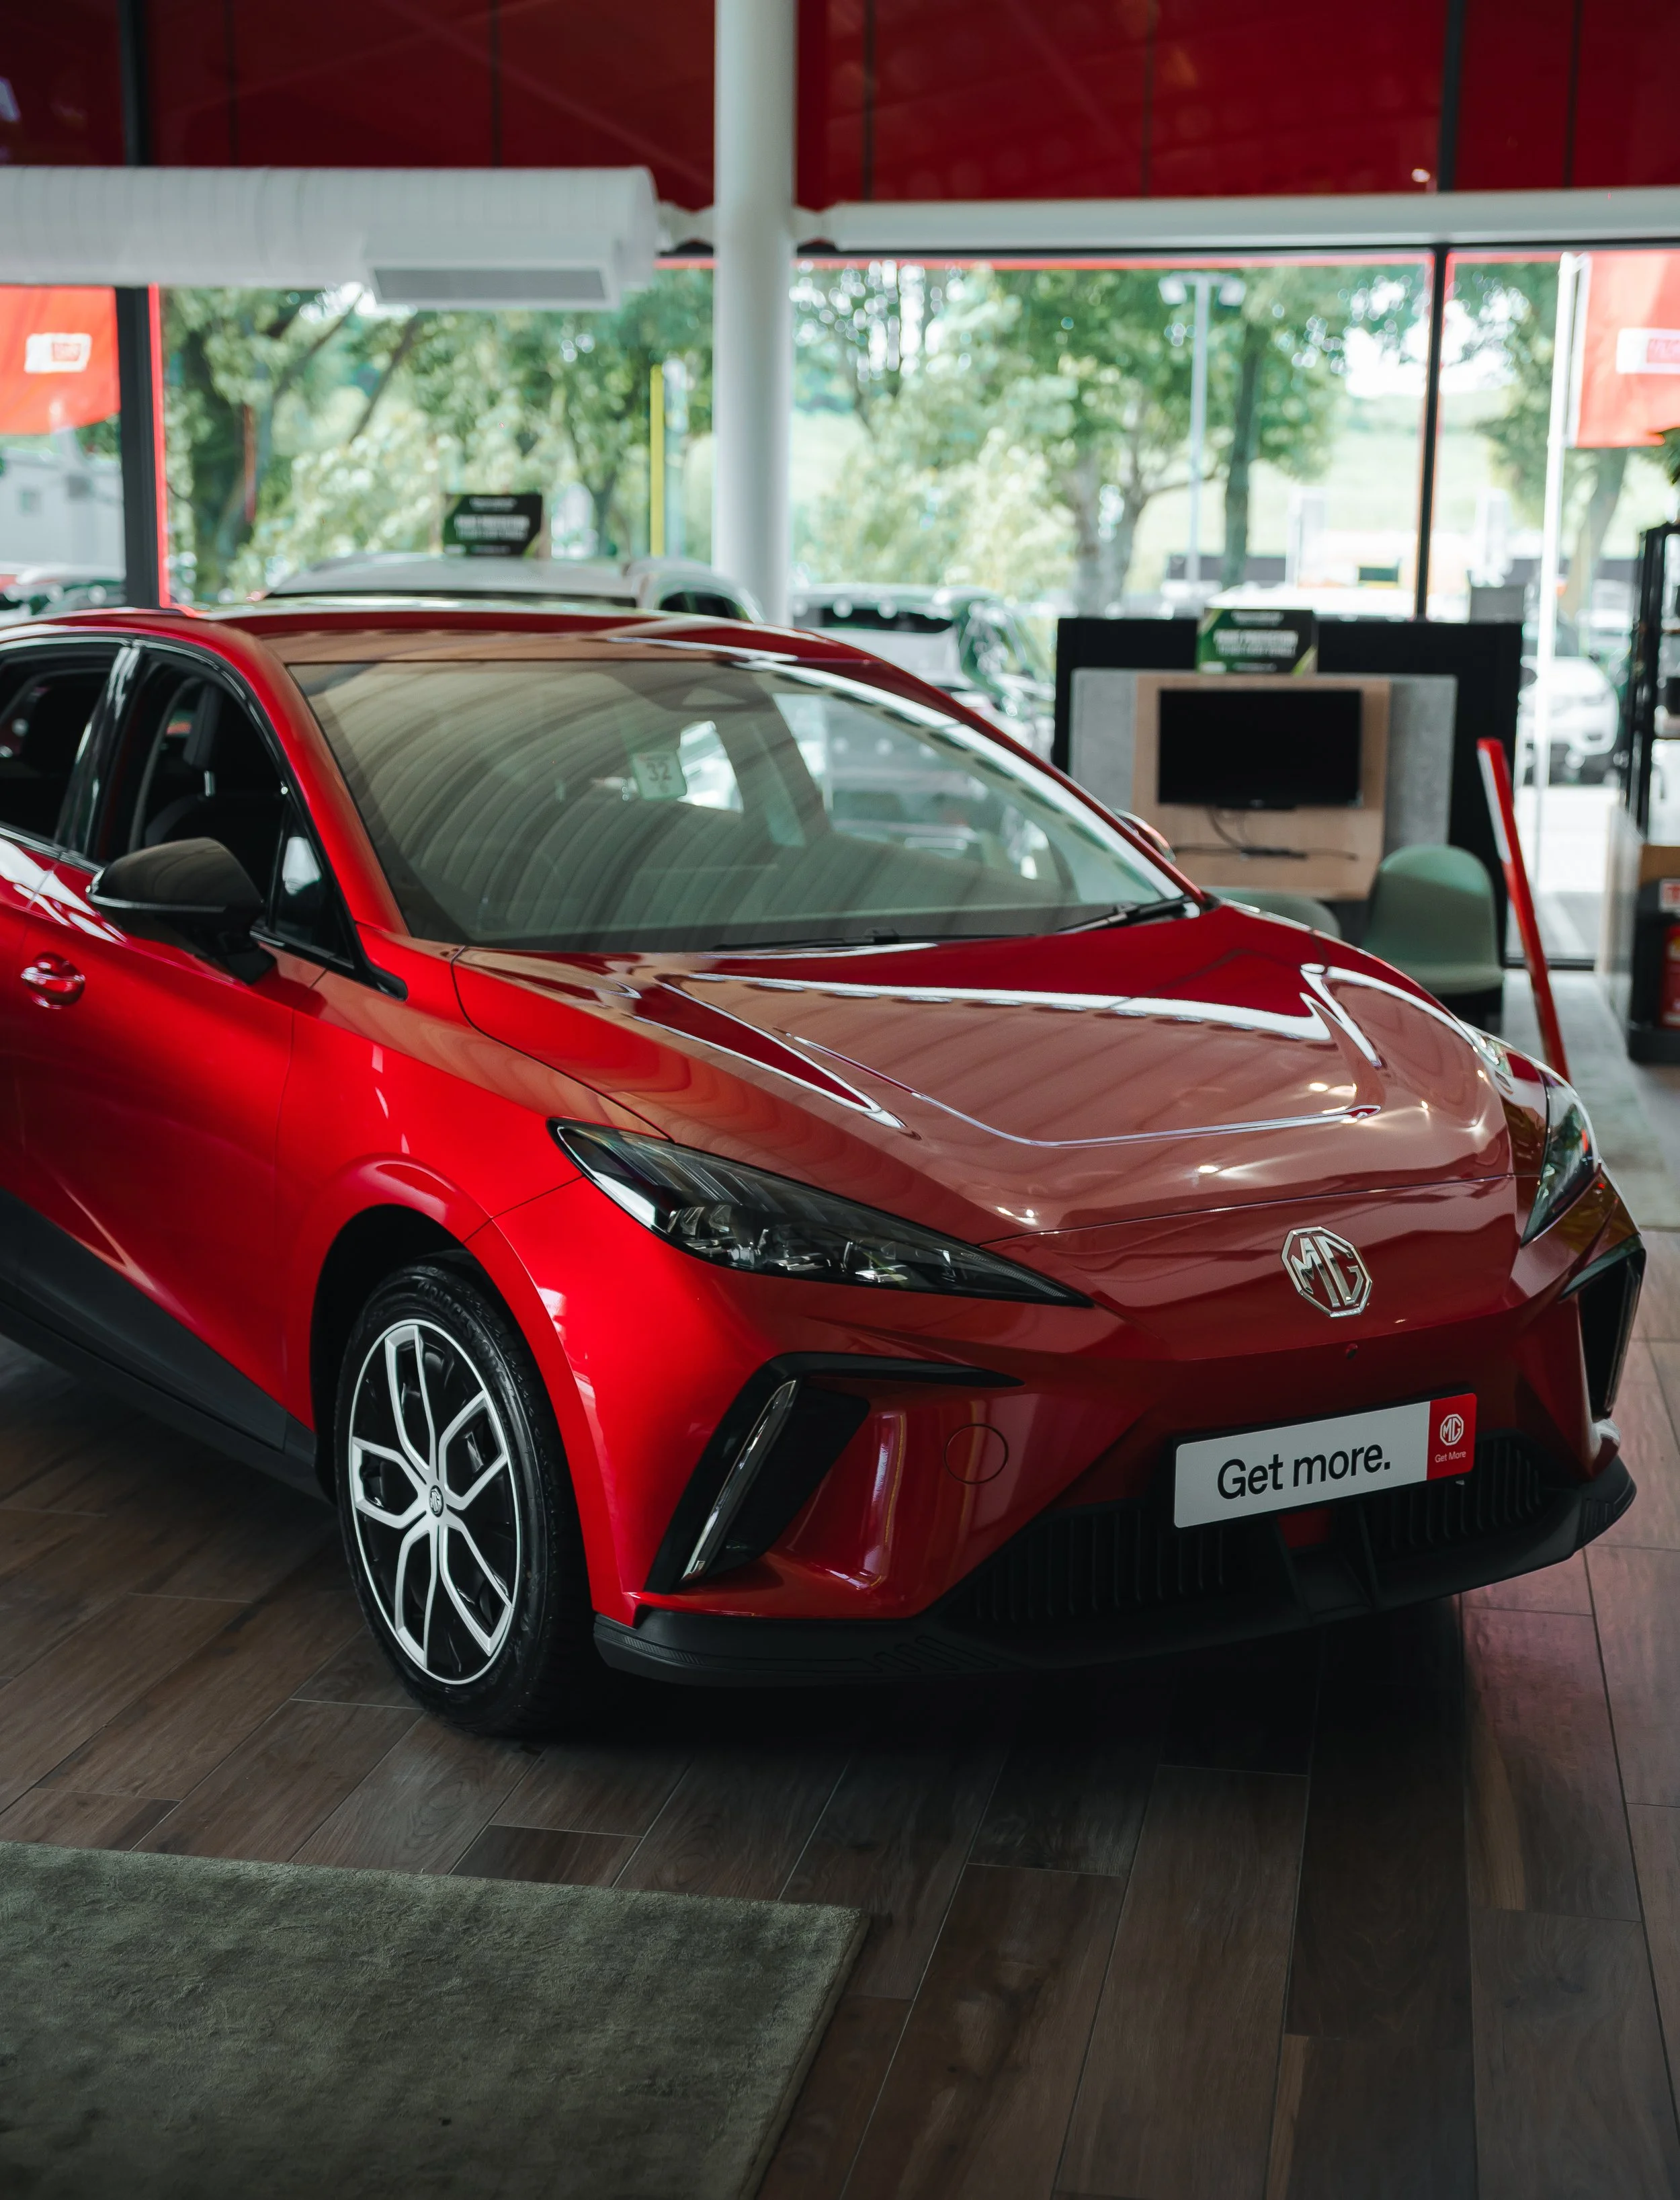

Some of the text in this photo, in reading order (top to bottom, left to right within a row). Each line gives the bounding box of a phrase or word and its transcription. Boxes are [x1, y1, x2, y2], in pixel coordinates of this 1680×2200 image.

[1290, 1234, 1365, 1308] MG
[1442, 1416, 1462, 1442] MG
[1217, 1444, 1391, 1500] Get more.
[1435, 1451, 1466, 1463] Get More
